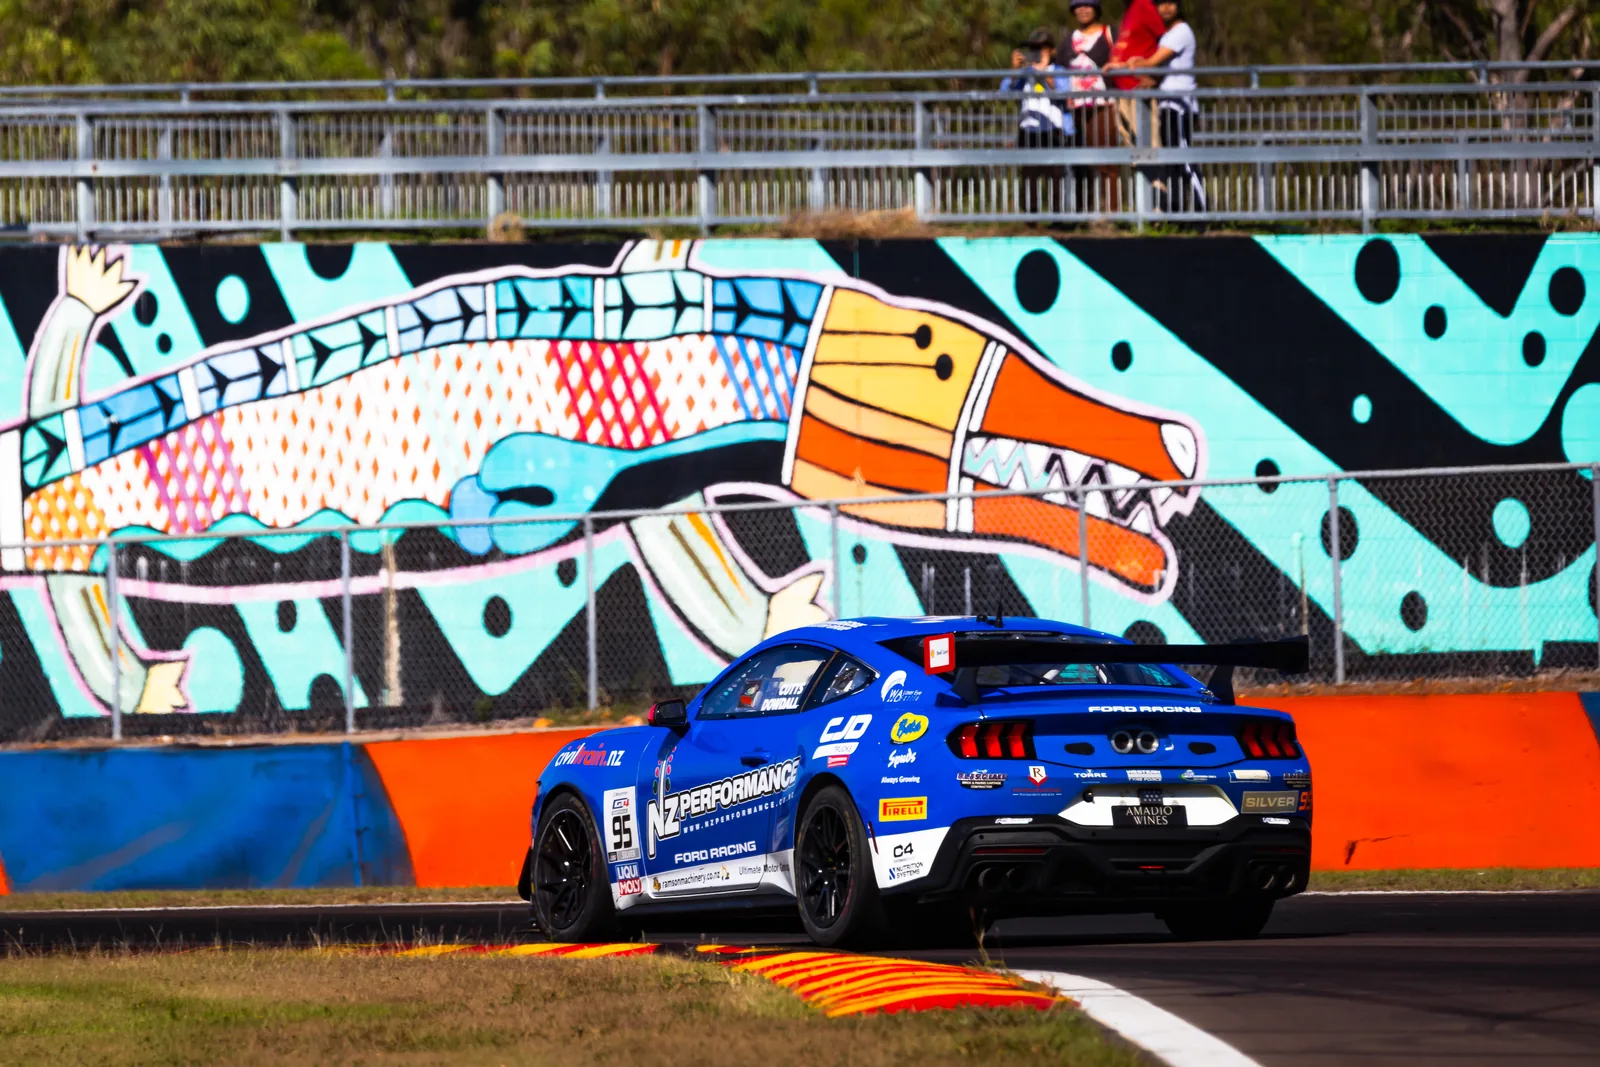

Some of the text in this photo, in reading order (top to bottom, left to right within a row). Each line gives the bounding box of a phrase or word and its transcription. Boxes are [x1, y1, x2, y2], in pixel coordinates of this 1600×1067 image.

[779, 683, 805, 695] CUTTS
[761, 697, 799, 711] DOWDALL
[819, 714, 873, 743] CJD
[555, 742, 625, 767] civiltrain.nz
[887, 748, 916, 768] Spuds
[899, 775, 920, 784] Growing
[1032, 768, 1043, 777] R
[883, 801, 923, 816] PIRELLI
[1245, 797, 1295, 807] SILVER
[1126, 806, 1173, 816] AMADIO
[1133, 815, 1168, 825] WINES
[612, 814, 632, 850] 95
[674, 840, 757, 864] FORD RACING
[893, 842, 914, 858] C4
[617, 864, 639, 879] LIQUI
[739, 865, 761, 876] Ultimate
[896, 862, 924, 872] NUTRITION
[896, 868, 920, 879] SYSTEMS
[662, 870, 720, 889] ramsonmachinery.co.nz
[620, 880, 641, 895] MOLY
